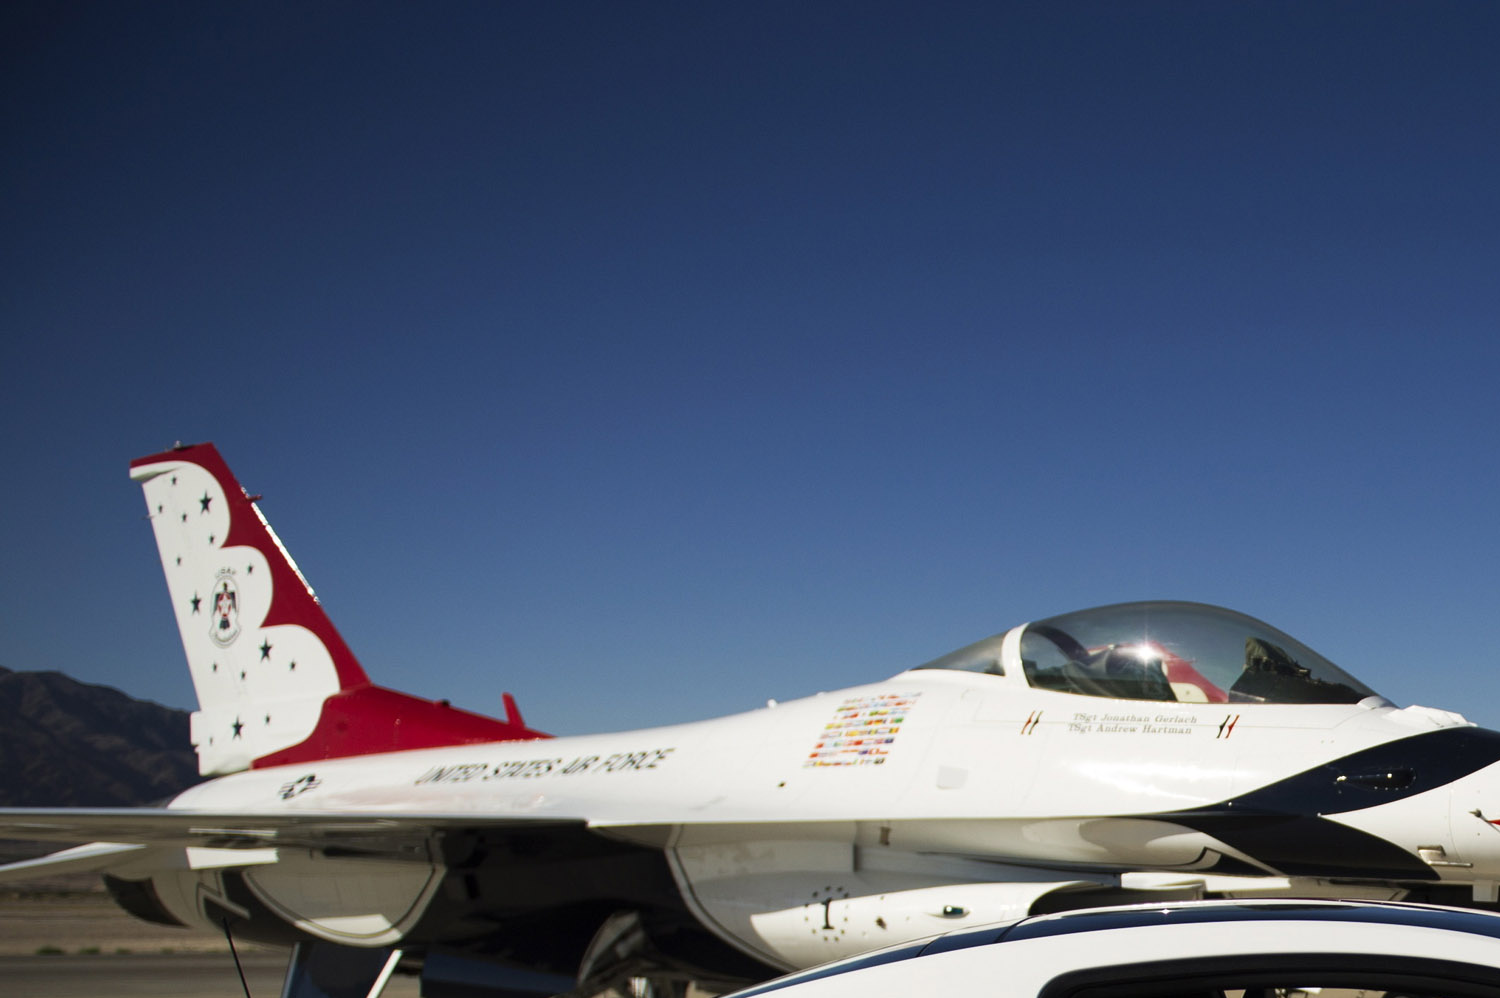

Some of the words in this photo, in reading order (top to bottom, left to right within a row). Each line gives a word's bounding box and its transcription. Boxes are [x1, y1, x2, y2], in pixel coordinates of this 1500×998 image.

[1101, 713, 1150, 722] Jonathan
[1096, 723, 1138, 733] Andrew
[1142, 724, 1192, 735] Hartman
[414, 762, 489, 785] UNITED
[484, 758, 562, 780] STATES
[552, 755, 600, 776] AIR
[591, 748, 676, 773] FORCE
[821, 897, 835, 930] 1
